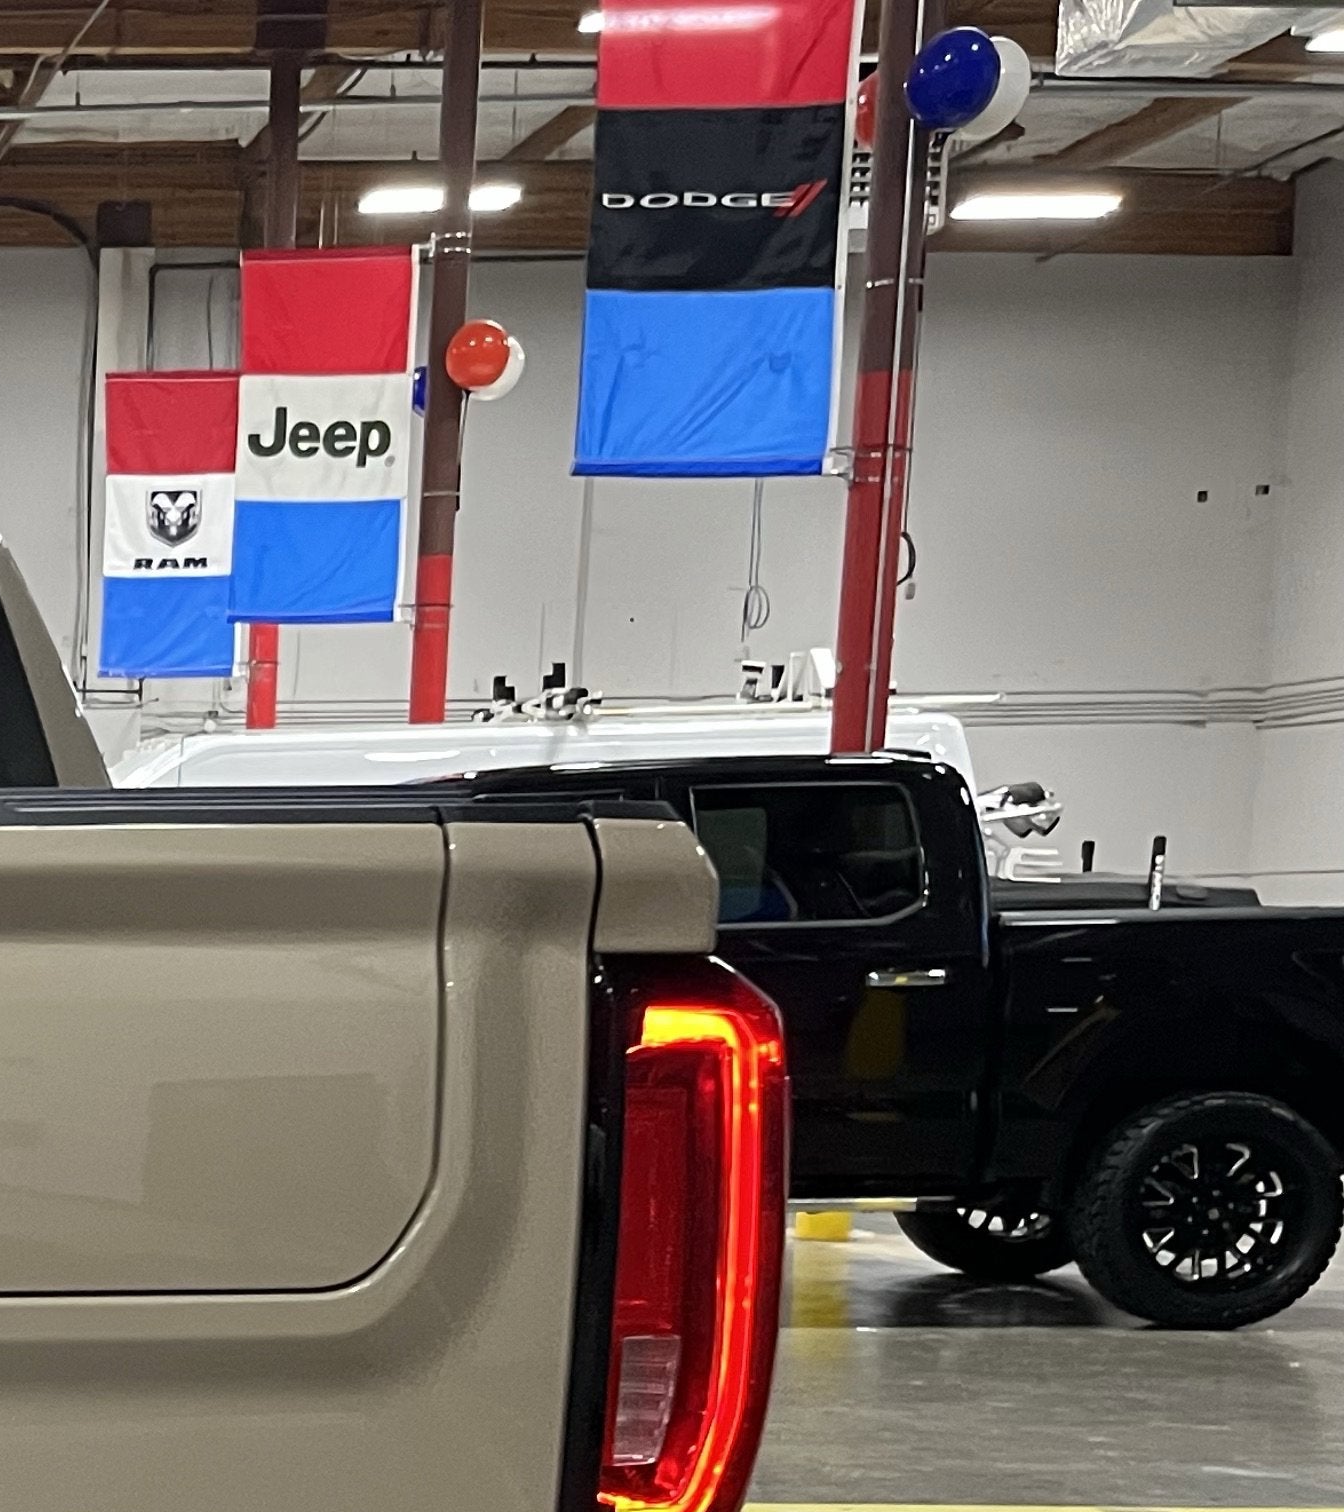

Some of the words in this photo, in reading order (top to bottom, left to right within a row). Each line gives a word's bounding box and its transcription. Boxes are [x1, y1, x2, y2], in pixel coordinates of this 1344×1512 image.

[602, 192, 795, 208] DODGE
[248, 407, 391, 467] Jeep
[134, 558, 207, 570] RAM
